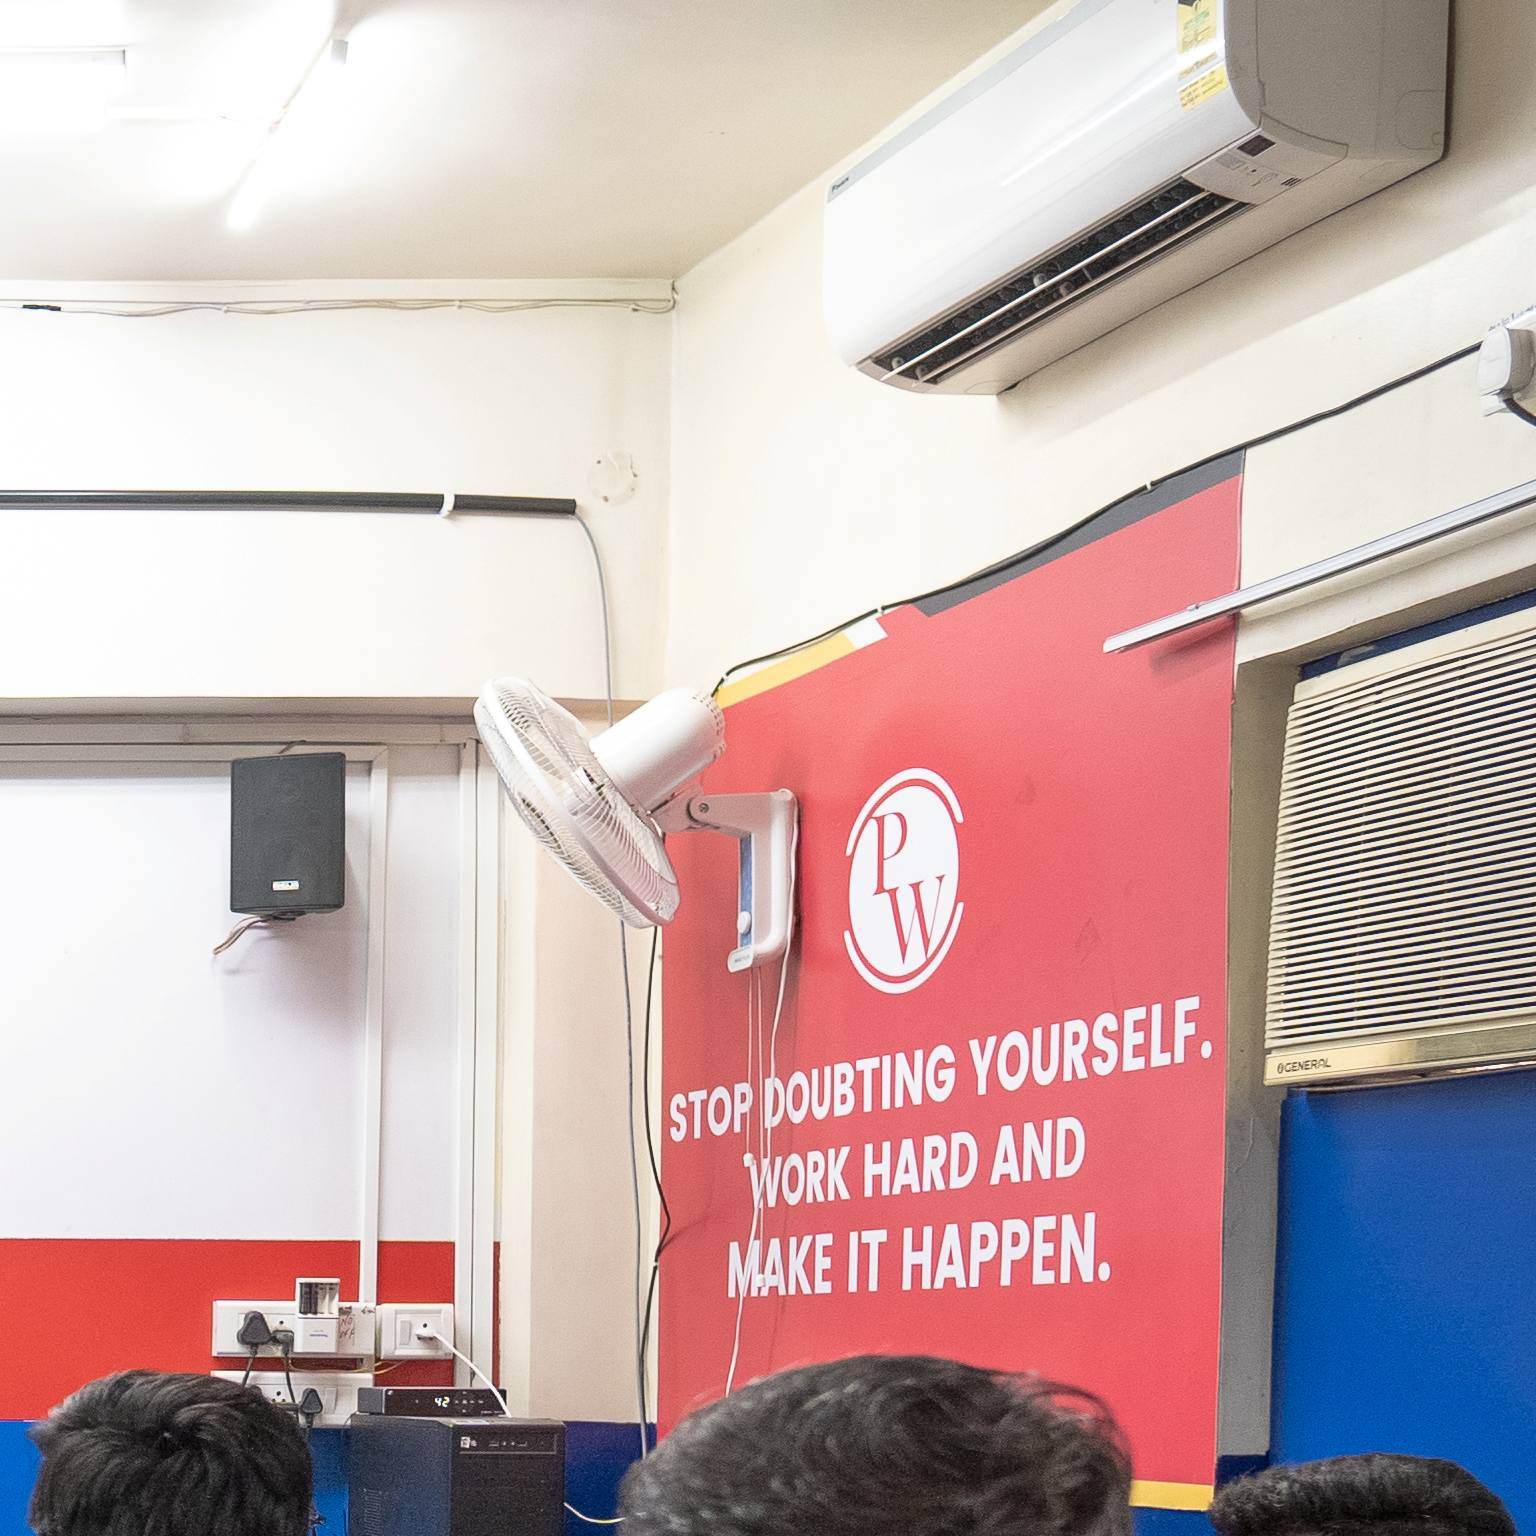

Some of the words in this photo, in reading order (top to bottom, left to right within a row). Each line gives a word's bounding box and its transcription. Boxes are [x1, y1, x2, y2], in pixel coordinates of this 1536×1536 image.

[870, 810, 947, 966] PW
[670, 1082, 753, 1143] STOP
[764, 1043, 958, 1129] DOUBTING
[969, 996, 1213, 1096] YOURSELF.
[749, 1146, 851, 1208] WORK
[864, 1131, 978, 1198] HARD
[989, 1116, 1086, 1185] AND
[728, 1233, 833, 1297] MAKE
[848, 1229, 888, 1293] IT
[902, 1212, 1111, 1291] HAPPEN.
